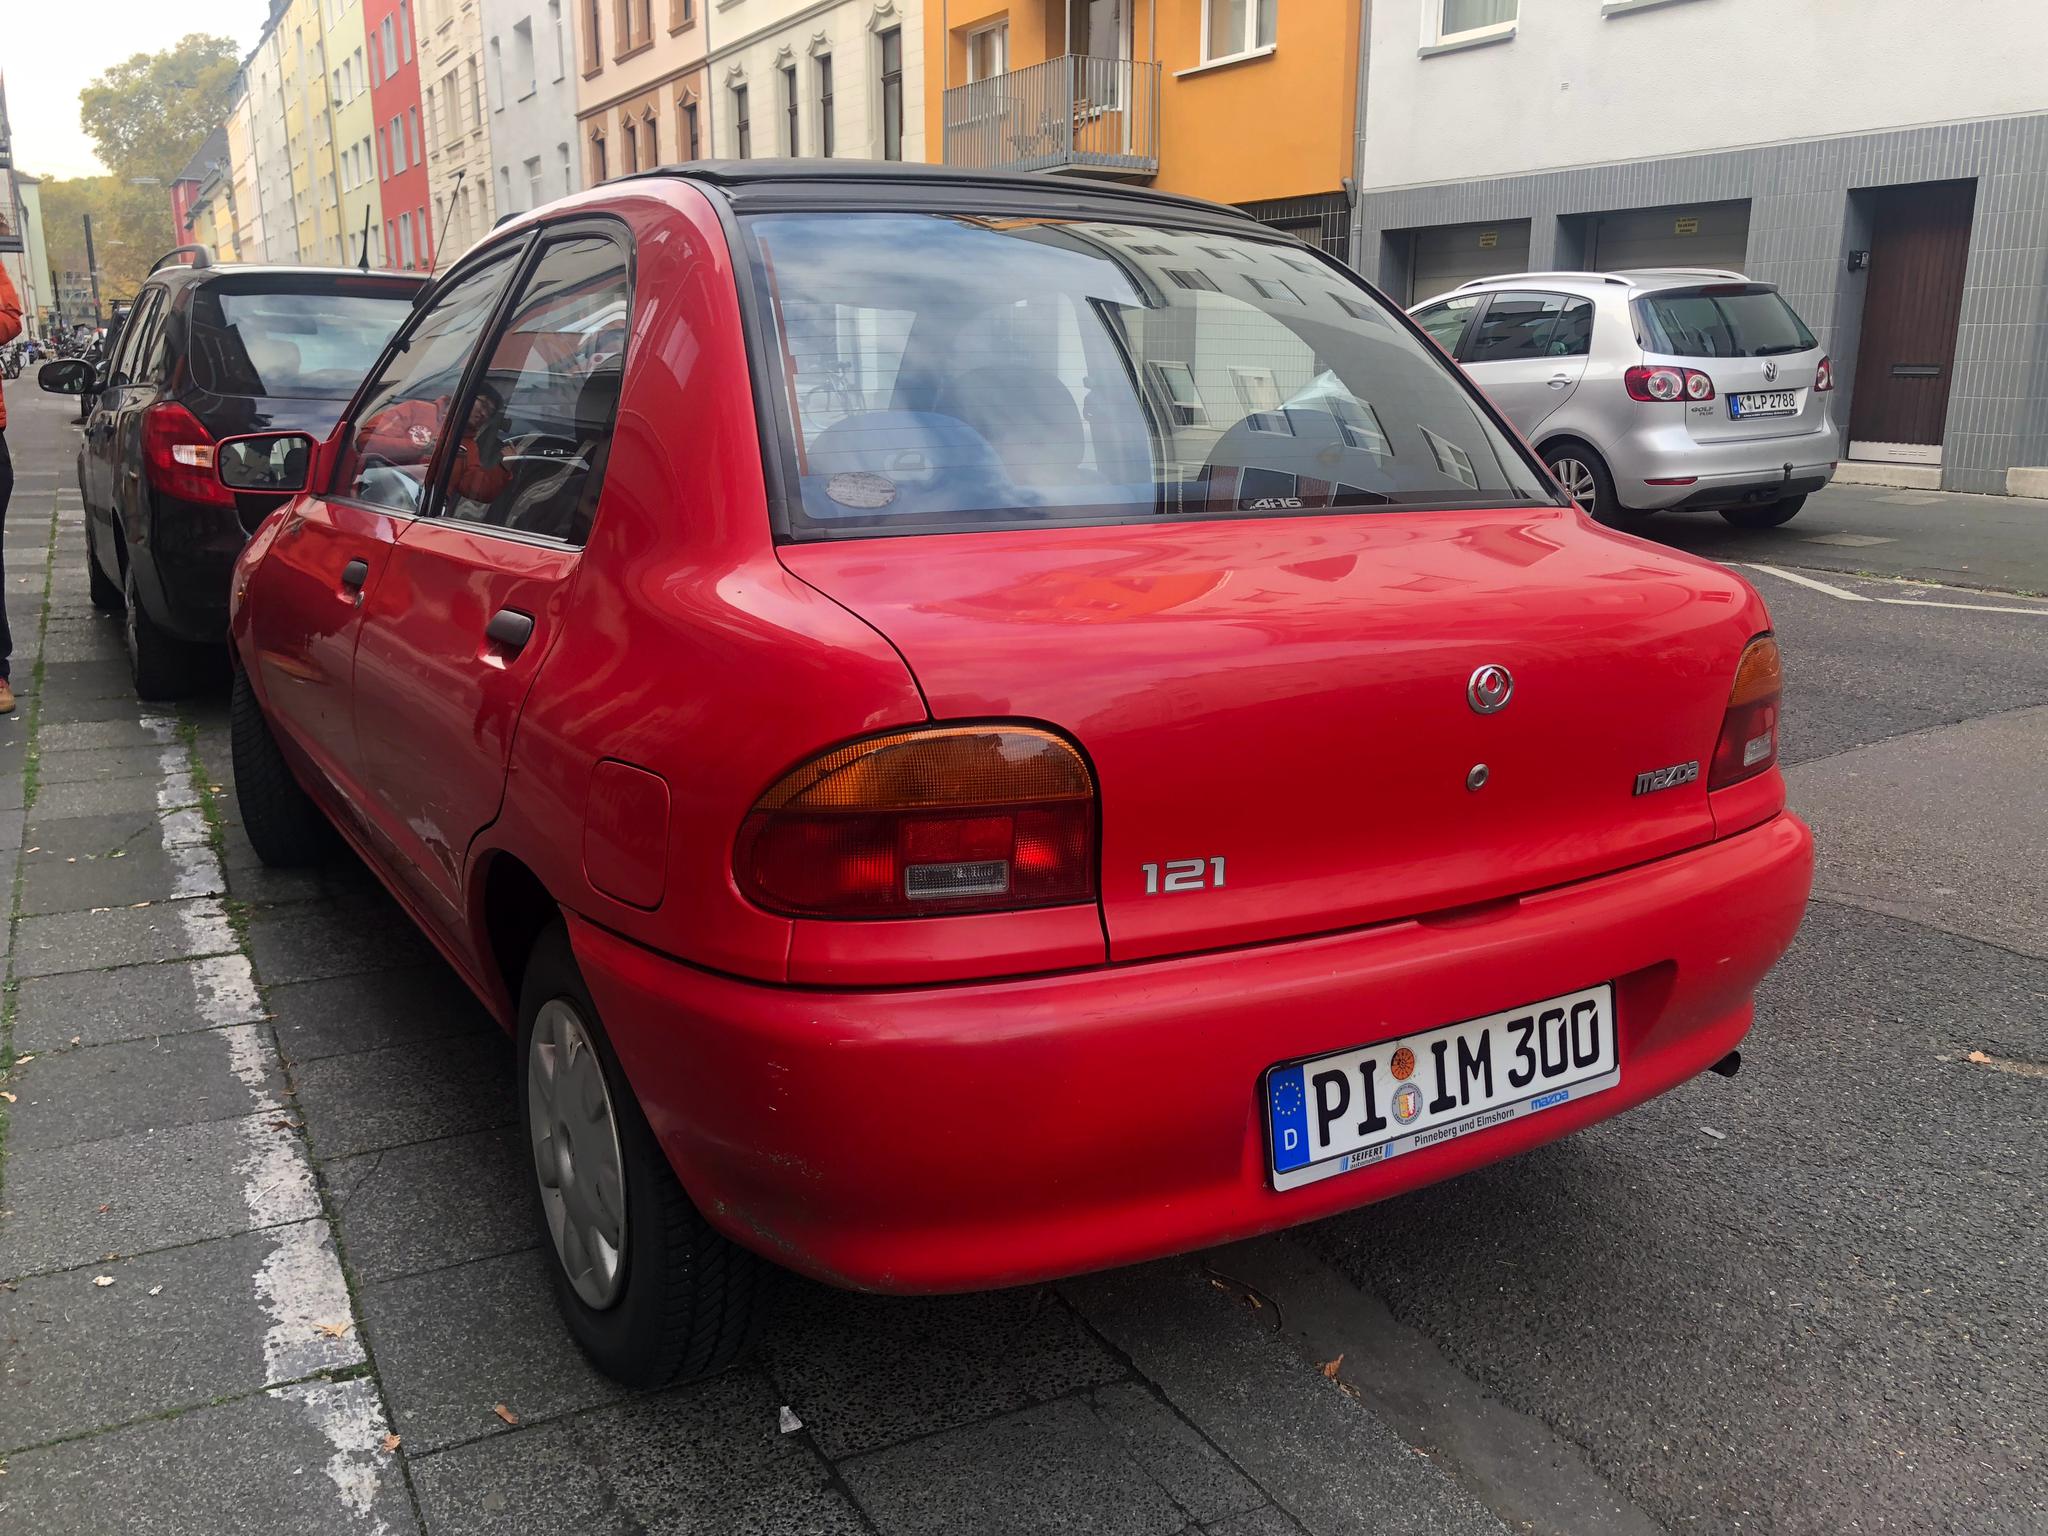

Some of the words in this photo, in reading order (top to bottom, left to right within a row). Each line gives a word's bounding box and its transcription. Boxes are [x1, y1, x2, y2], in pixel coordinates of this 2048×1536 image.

[1738, 396, 1747, 411] K
[1752, 394, 1768, 410] LP
[1769, 392, 1796, 409] 2788
[1632, 760, 1700, 797] mazda
[1142, 856, 1226, 895] 121
[1283, 1128, 1298, 1151] D
[1312, 1059, 1387, 1147] PI
[1429, 1028, 1494, 1114] IM
[1507, 999, 1600, 1088] 300
[1531, 1090, 1569, 1110] mazda
[1414, 1125, 1458, 1147] Pinneberg
[1459, 1119, 1475, 1133] und
[1477, 1108, 1516, 1127] Elmshorn
[1351, 1145, 1384, 1163] SEIFERT
